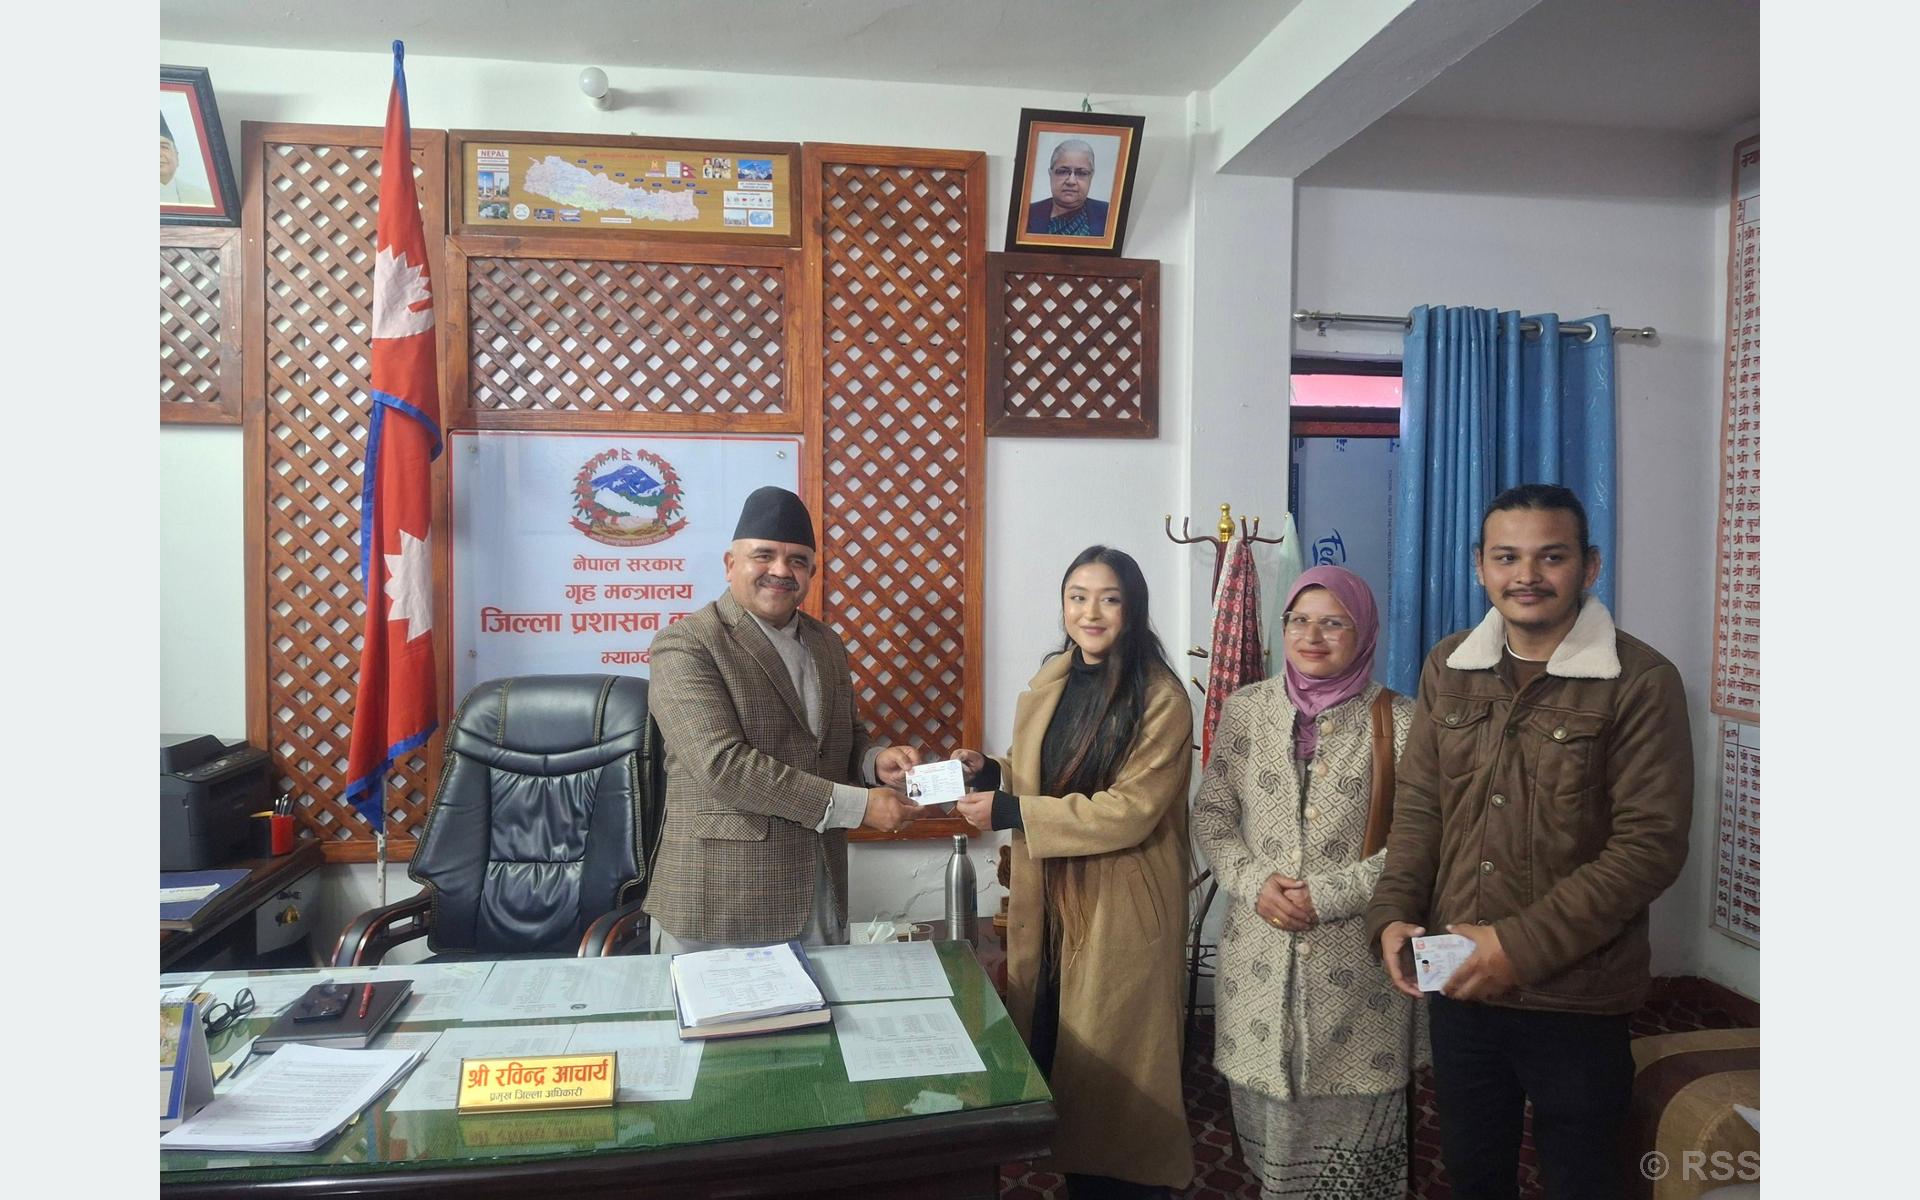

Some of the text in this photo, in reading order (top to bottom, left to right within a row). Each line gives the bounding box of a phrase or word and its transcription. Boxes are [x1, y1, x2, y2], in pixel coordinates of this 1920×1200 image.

[573, 554, 686, 572] नेपाल सरकार
[565, 584, 694, 605] गृह मन्त्रालय
[480, 607, 563, 634] जिल्ला
[570, 612, 661, 635] प्रशासन
[467, 1058, 609, 1089] श्री रविन्द्र आचार्य
[489, 1086, 583, 1103] प्रमुख जिल्ला अधिकारी
